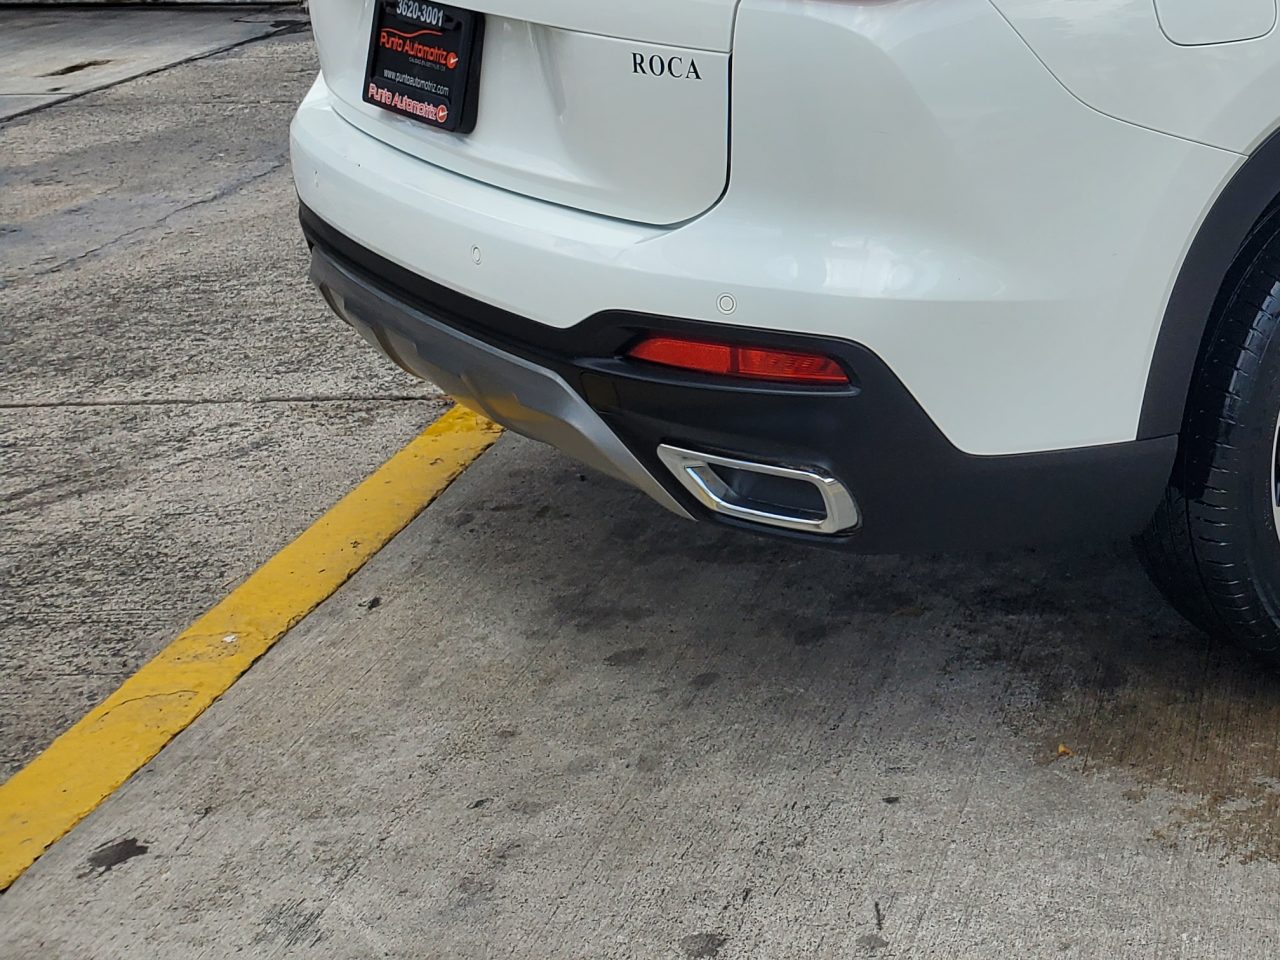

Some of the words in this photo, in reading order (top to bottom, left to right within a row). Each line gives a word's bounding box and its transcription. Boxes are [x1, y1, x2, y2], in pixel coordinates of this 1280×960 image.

[380, 31, 403, 52] Punto
[403, 40, 448, 65] Automotriz
[631, 52, 703, 80] ROCA
[383, 68, 450, 97] www.puntoautomotriz.com
[368, 82, 392, 105] Punto
[392, 92, 438, 121] Automotriz
